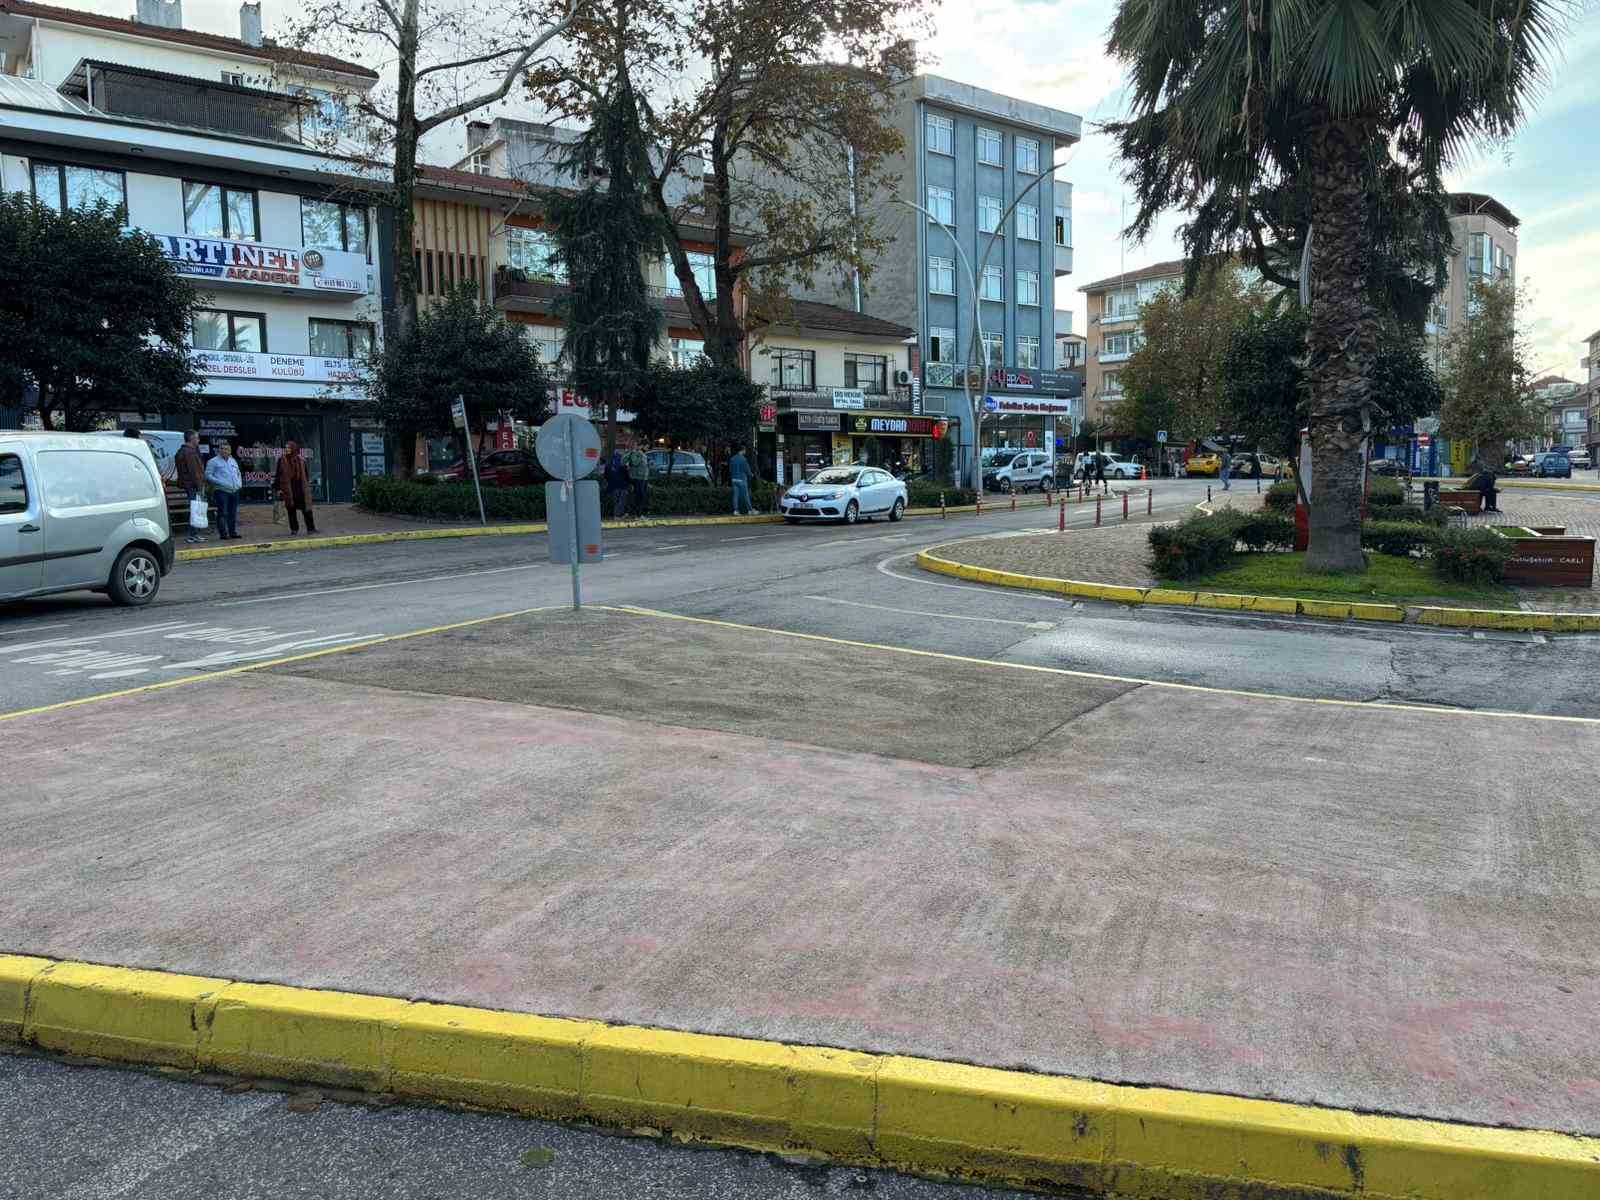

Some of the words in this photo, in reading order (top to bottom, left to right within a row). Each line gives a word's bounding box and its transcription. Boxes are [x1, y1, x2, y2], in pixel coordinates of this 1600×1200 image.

[270, 356, 305, 367] DENEME
[223, 365, 257, 375] DERSLER
[271, 367, 305, 377] KULÜBÜ
[871, 418, 908, 433] MEYDAN
